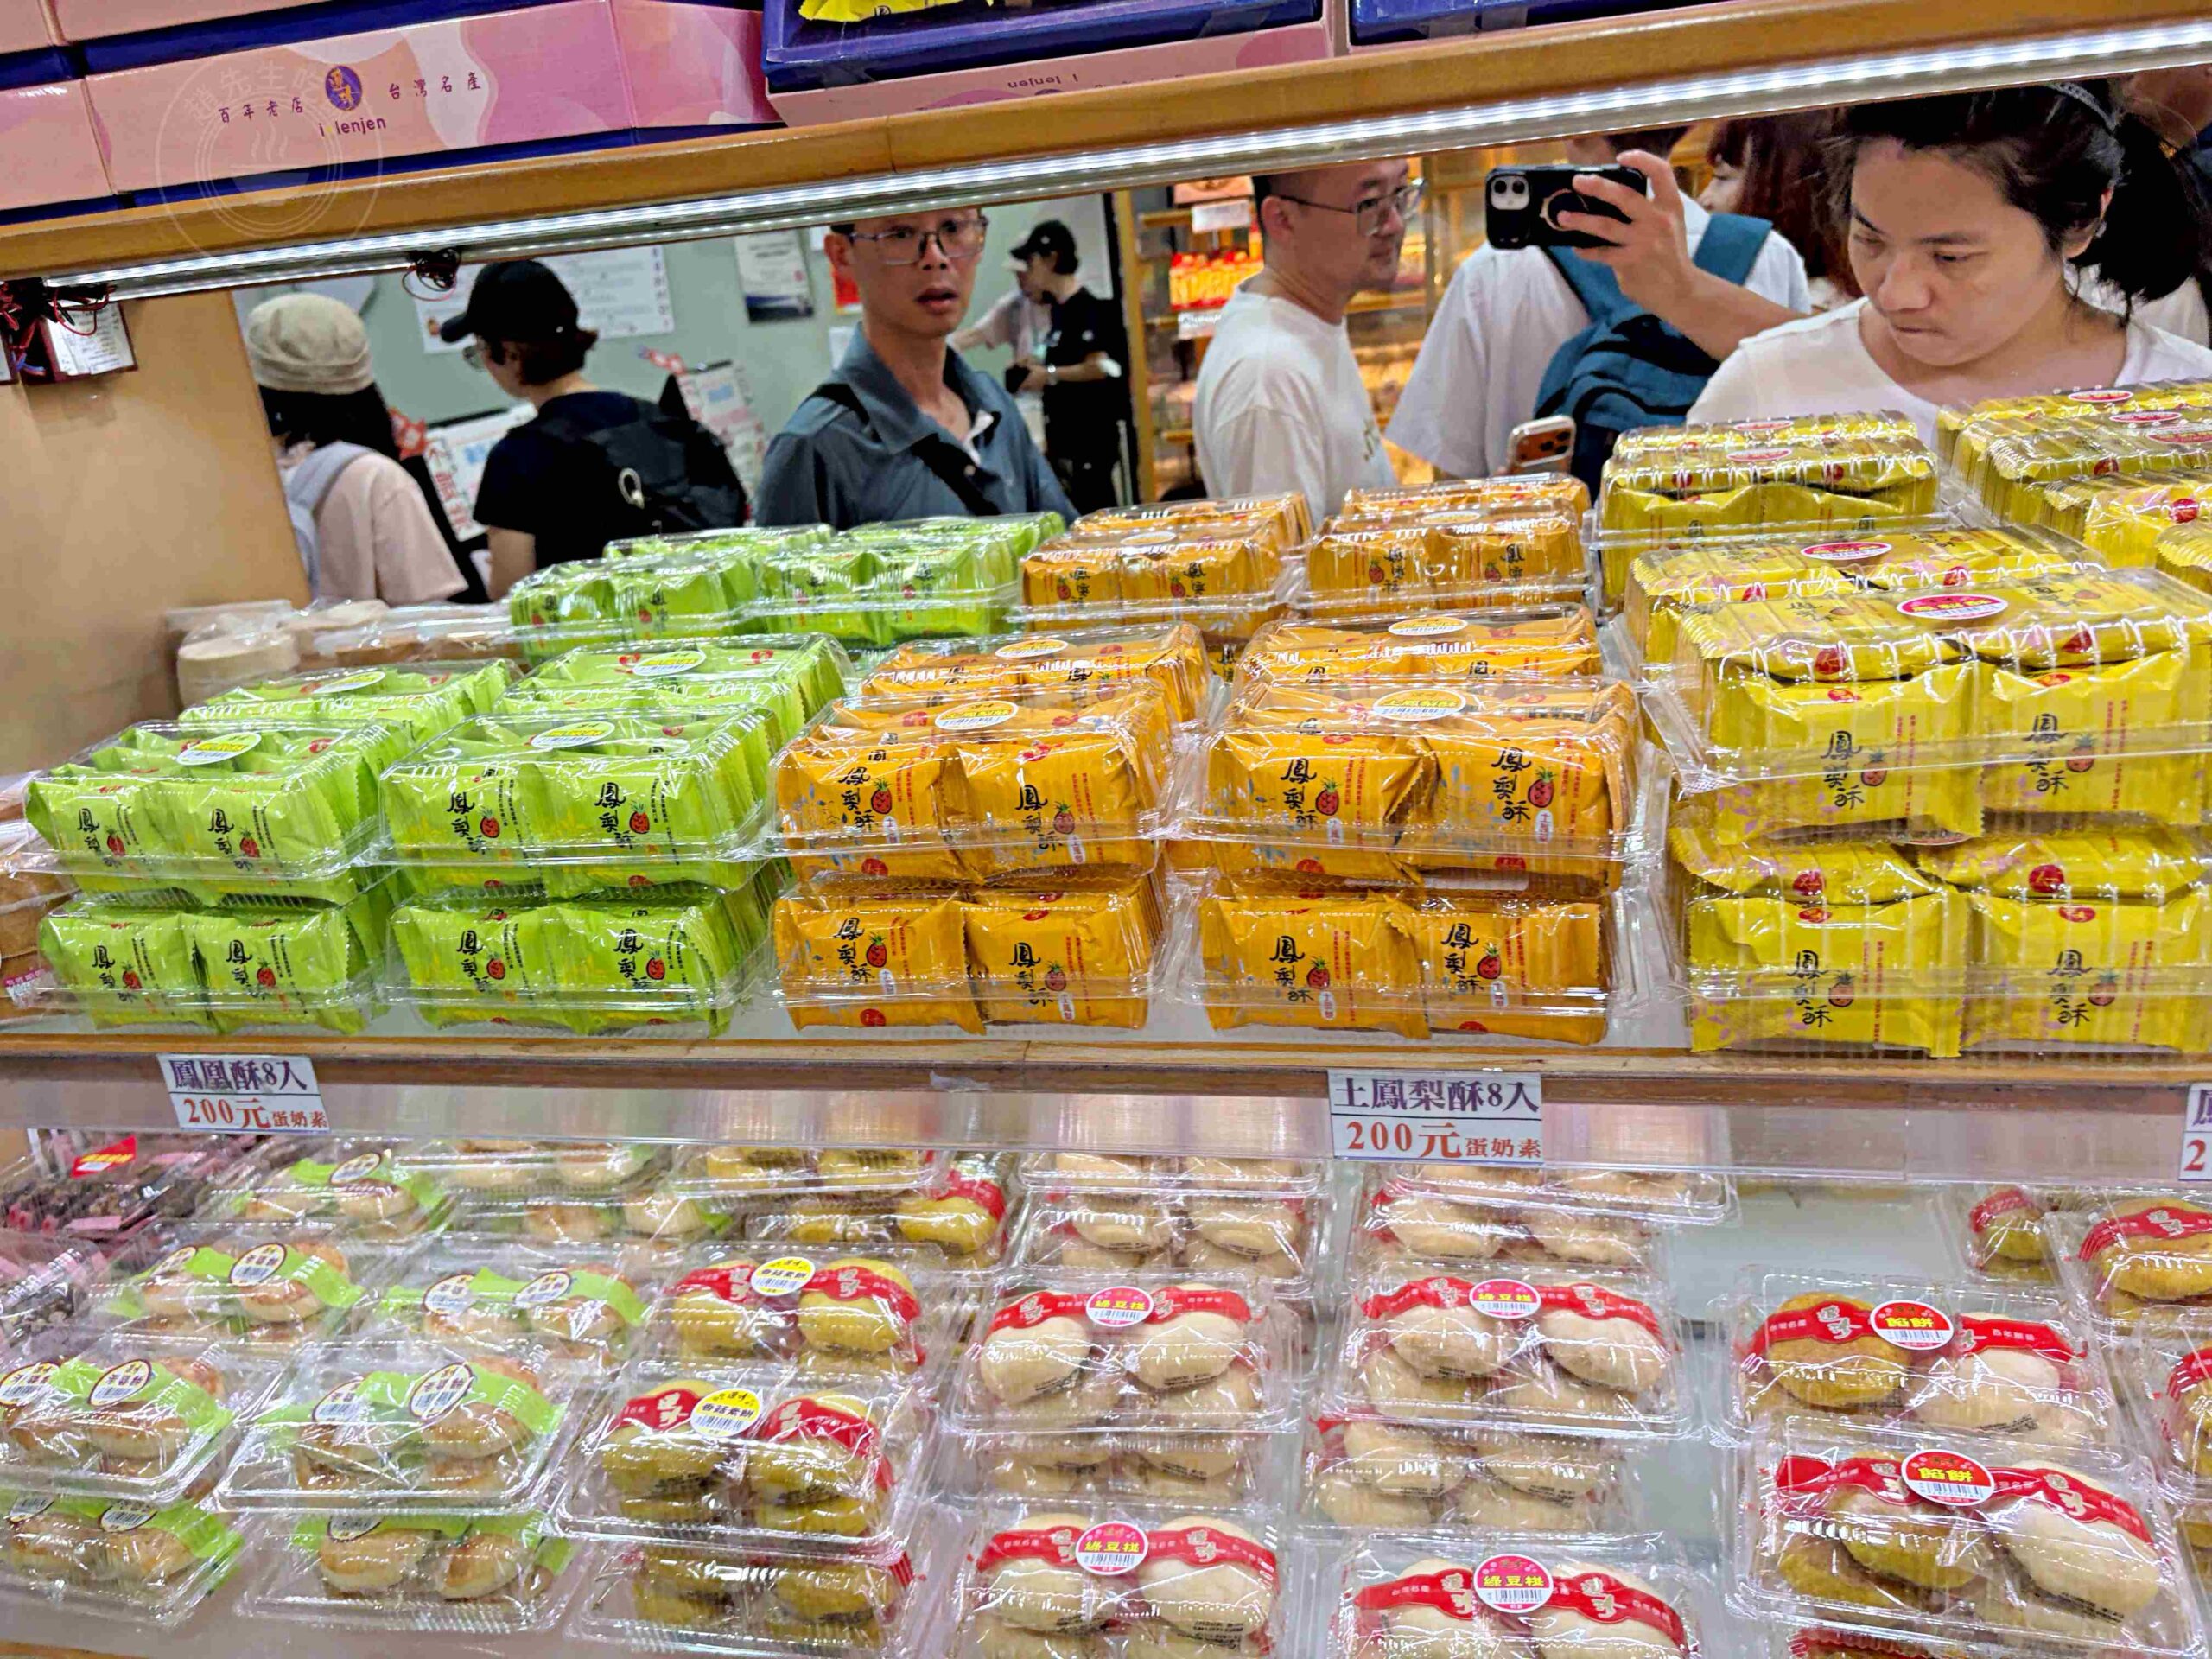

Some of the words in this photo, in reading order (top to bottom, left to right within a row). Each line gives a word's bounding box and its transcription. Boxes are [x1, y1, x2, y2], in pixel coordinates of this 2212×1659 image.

[389, 71, 482, 101] 台灣名產
[218, 97, 304, 124] 百年老店
[334, 117, 387, 136] lenjen
[838, 766, 876, 831] 鳳梨酥
[1279, 757, 1319, 830] 鳳梨酥
[1491, 746, 1532, 824] 鳳梨酥
[833, 917, 875, 982] 鳳梨酥
[1440, 923, 1485, 995] 鳳梨酥
[1269, 935, 1314, 1003] 鳳梨酥
[169, 1058, 308, 1092] 鳳凰酥8入
[183, 1097, 272, 1129] 200元
[272, 1109, 329, 1129] 蛋奶素
[1334, 1077, 1540, 1114] 土鳳梨酥8入
[1345, 1121, 1463, 1160] 200元
[1465, 1137, 1542, 1160] 蛋奶素
[1917, 1466, 1974, 1484] 餡餅
[1482, 1574, 1545, 1587] 綠豆椪
